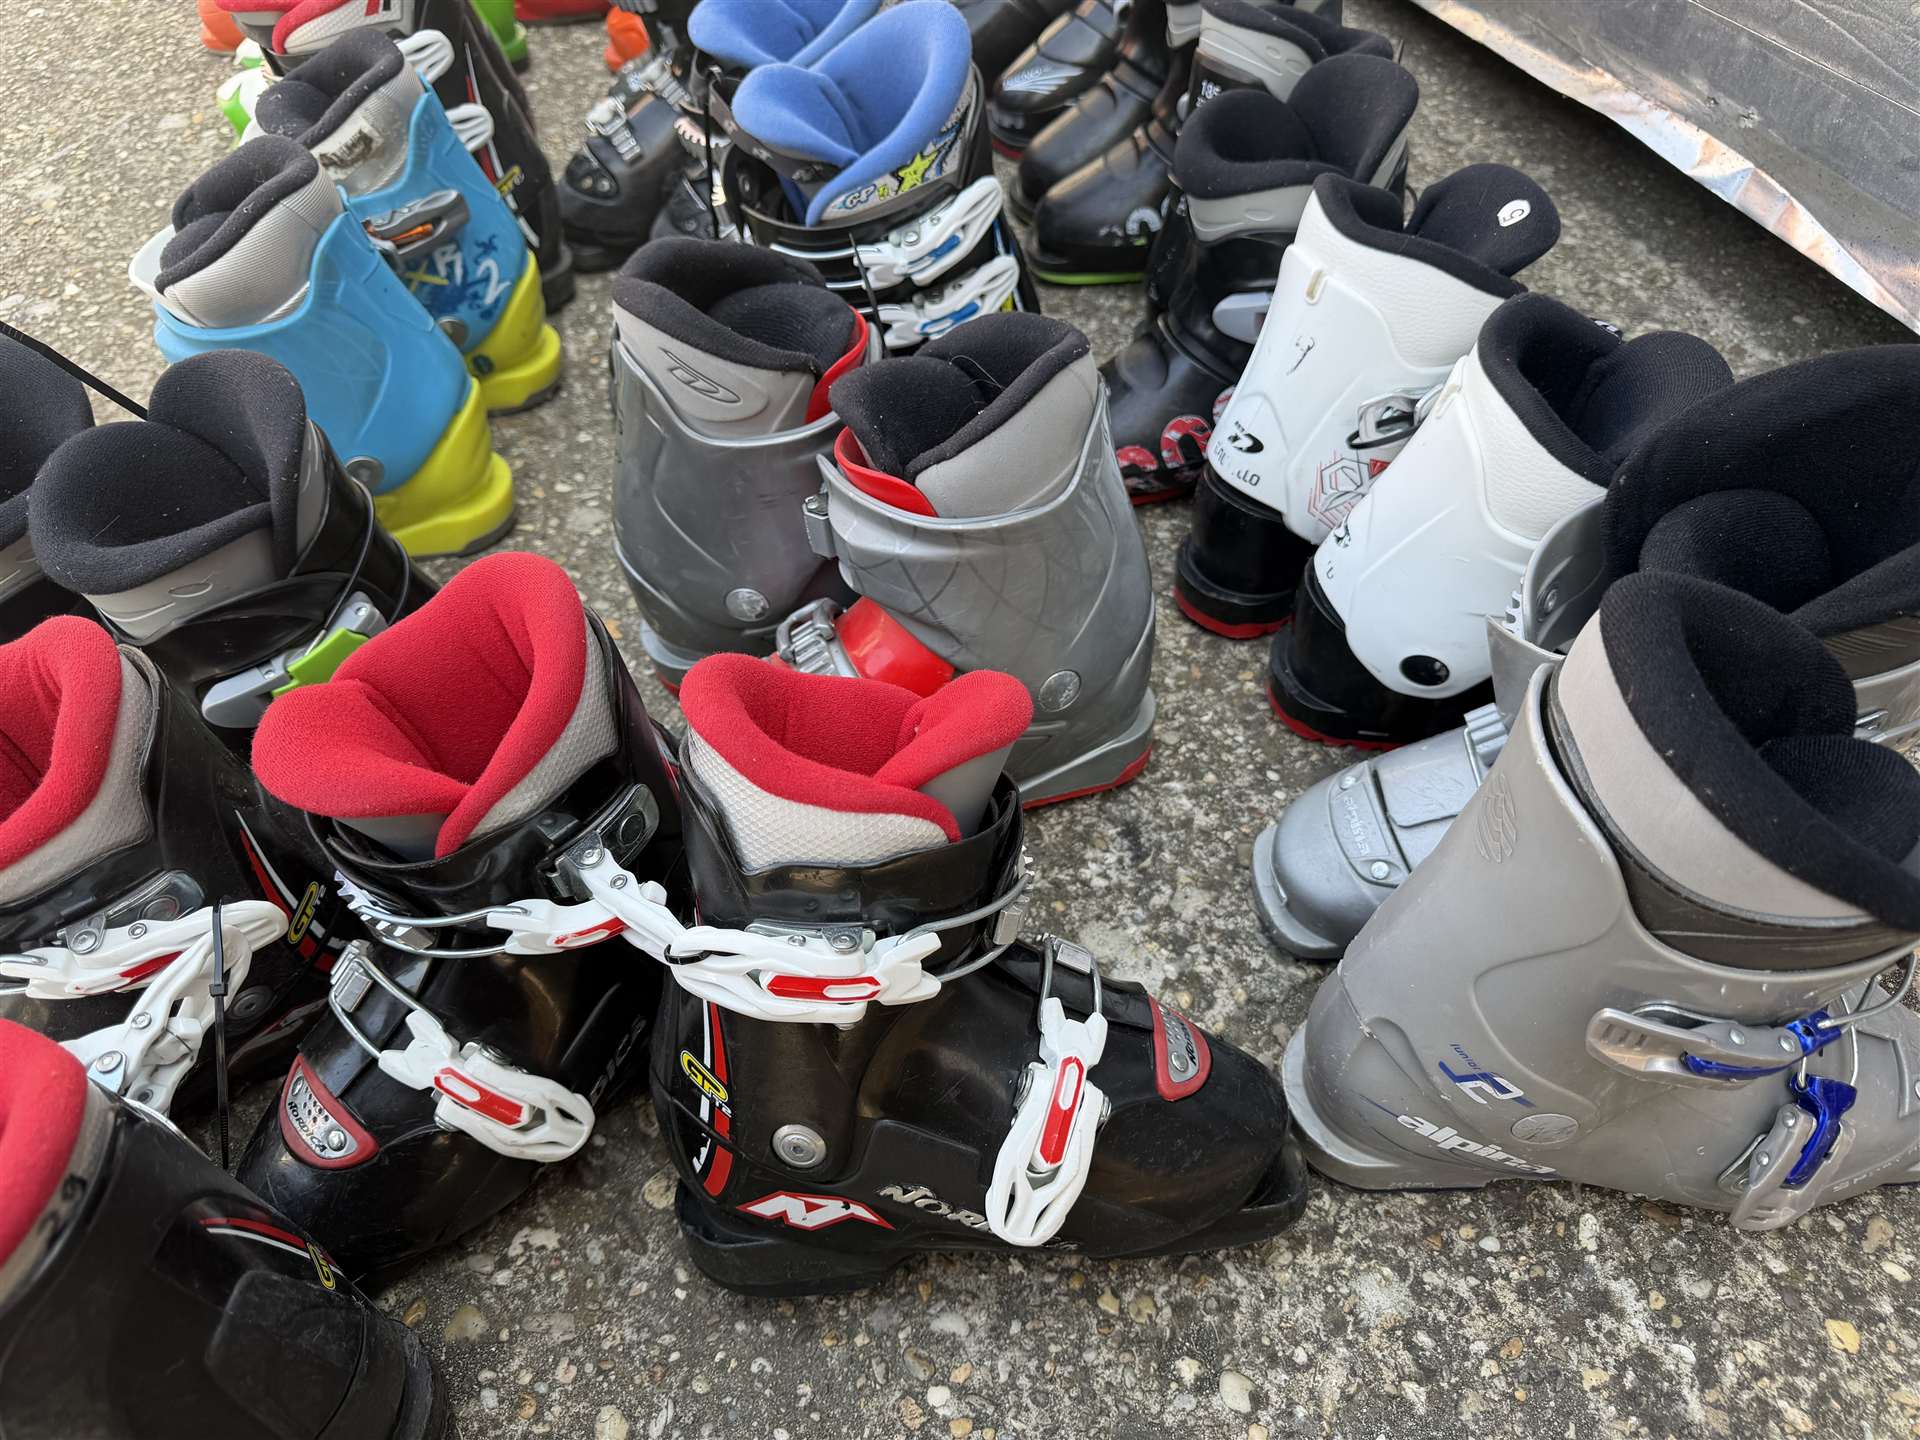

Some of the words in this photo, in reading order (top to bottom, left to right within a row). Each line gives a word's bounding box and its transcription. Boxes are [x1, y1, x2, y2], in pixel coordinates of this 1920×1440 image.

[288, 881, 320, 944] GP
[681, 1050, 729, 1102] GP
[287, 1101, 328, 1153] NORDICA
[1397, 1113, 1557, 1174] alpina
